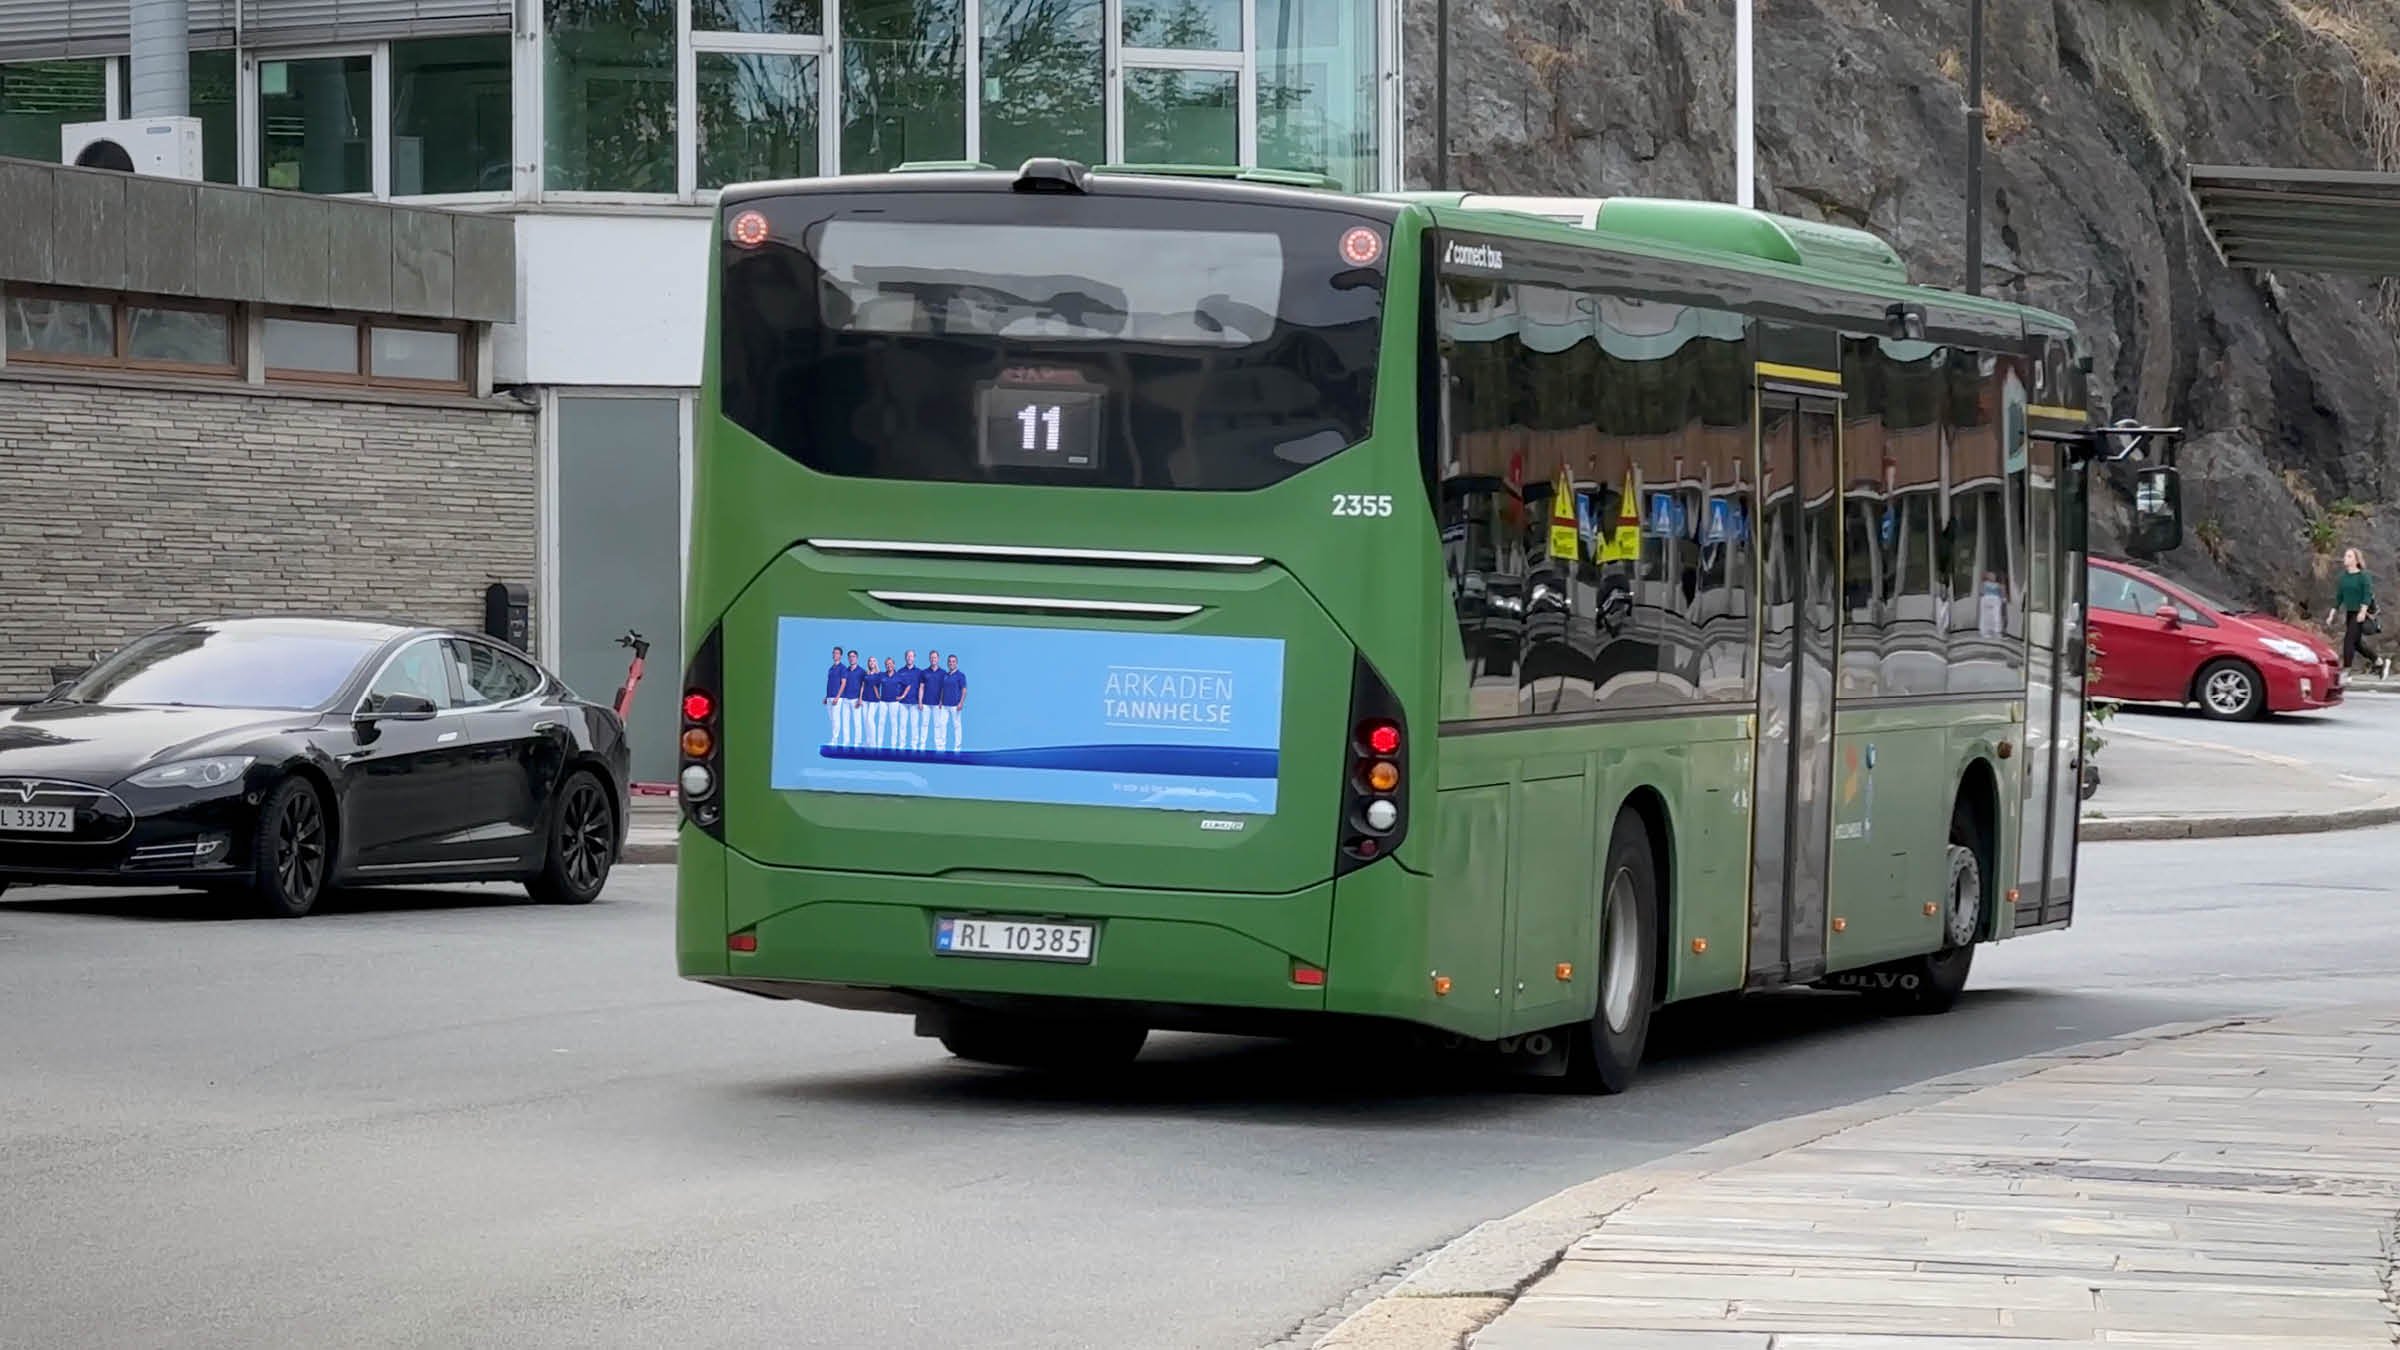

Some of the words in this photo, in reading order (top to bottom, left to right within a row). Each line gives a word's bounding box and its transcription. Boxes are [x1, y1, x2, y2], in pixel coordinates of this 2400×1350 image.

[1453, 243, 1487, 268] connect
[1487, 244, 1503, 270] bus
[1017, 405, 1061, 450] 11
[1331, 494, 1393, 517] 2355
[1104, 671, 1233, 700] ARKADEN
[1103, 699, 1232, 723] TANNHELSE
[16, 809, 67, 828] 33372
[960, 923, 990, 949] RL
[1004, 926, 1082, 953] 10385
